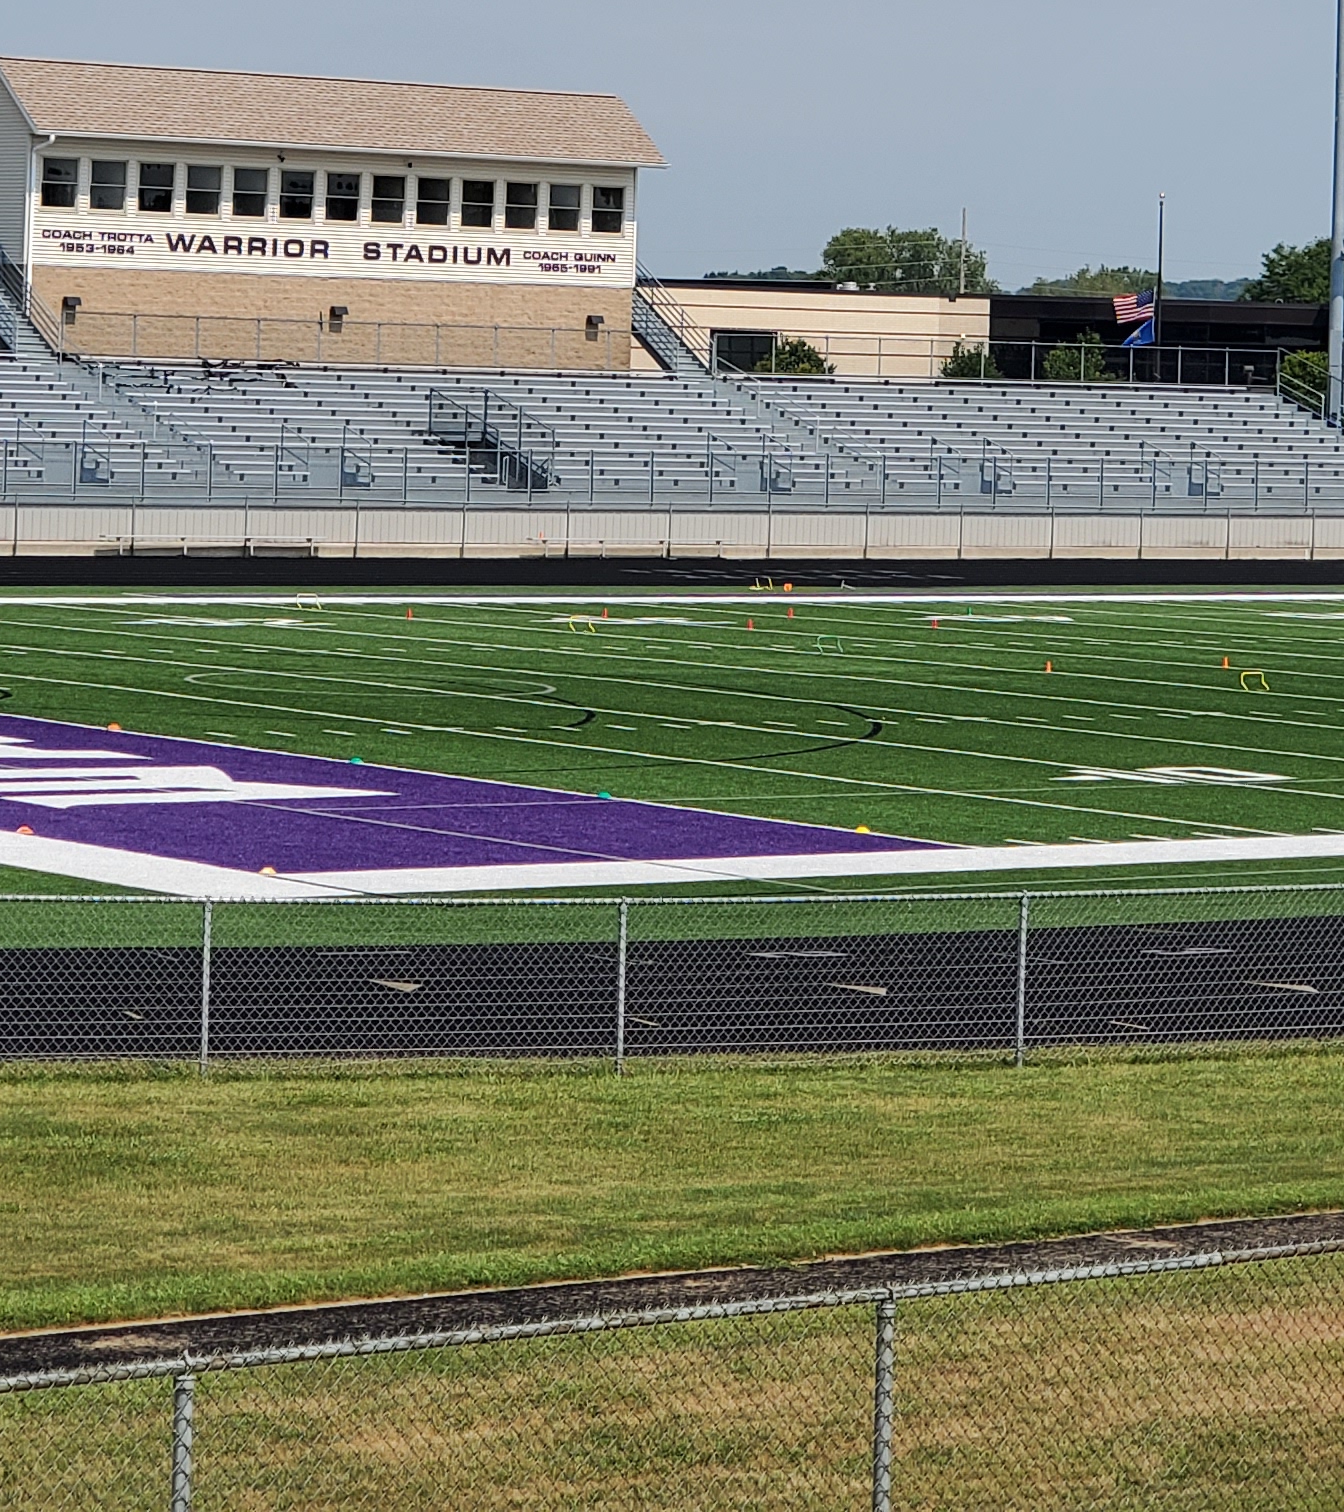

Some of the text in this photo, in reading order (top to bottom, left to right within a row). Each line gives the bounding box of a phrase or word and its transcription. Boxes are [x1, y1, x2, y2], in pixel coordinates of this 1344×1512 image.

[41, 228, 155, 244] COACH TROTTA
[59, 242, 135, 255] 1953-1964
[165, 231, 512, 268] WARRIOR STADIUM
[522, 250, 617, 263] COACH QUINN
